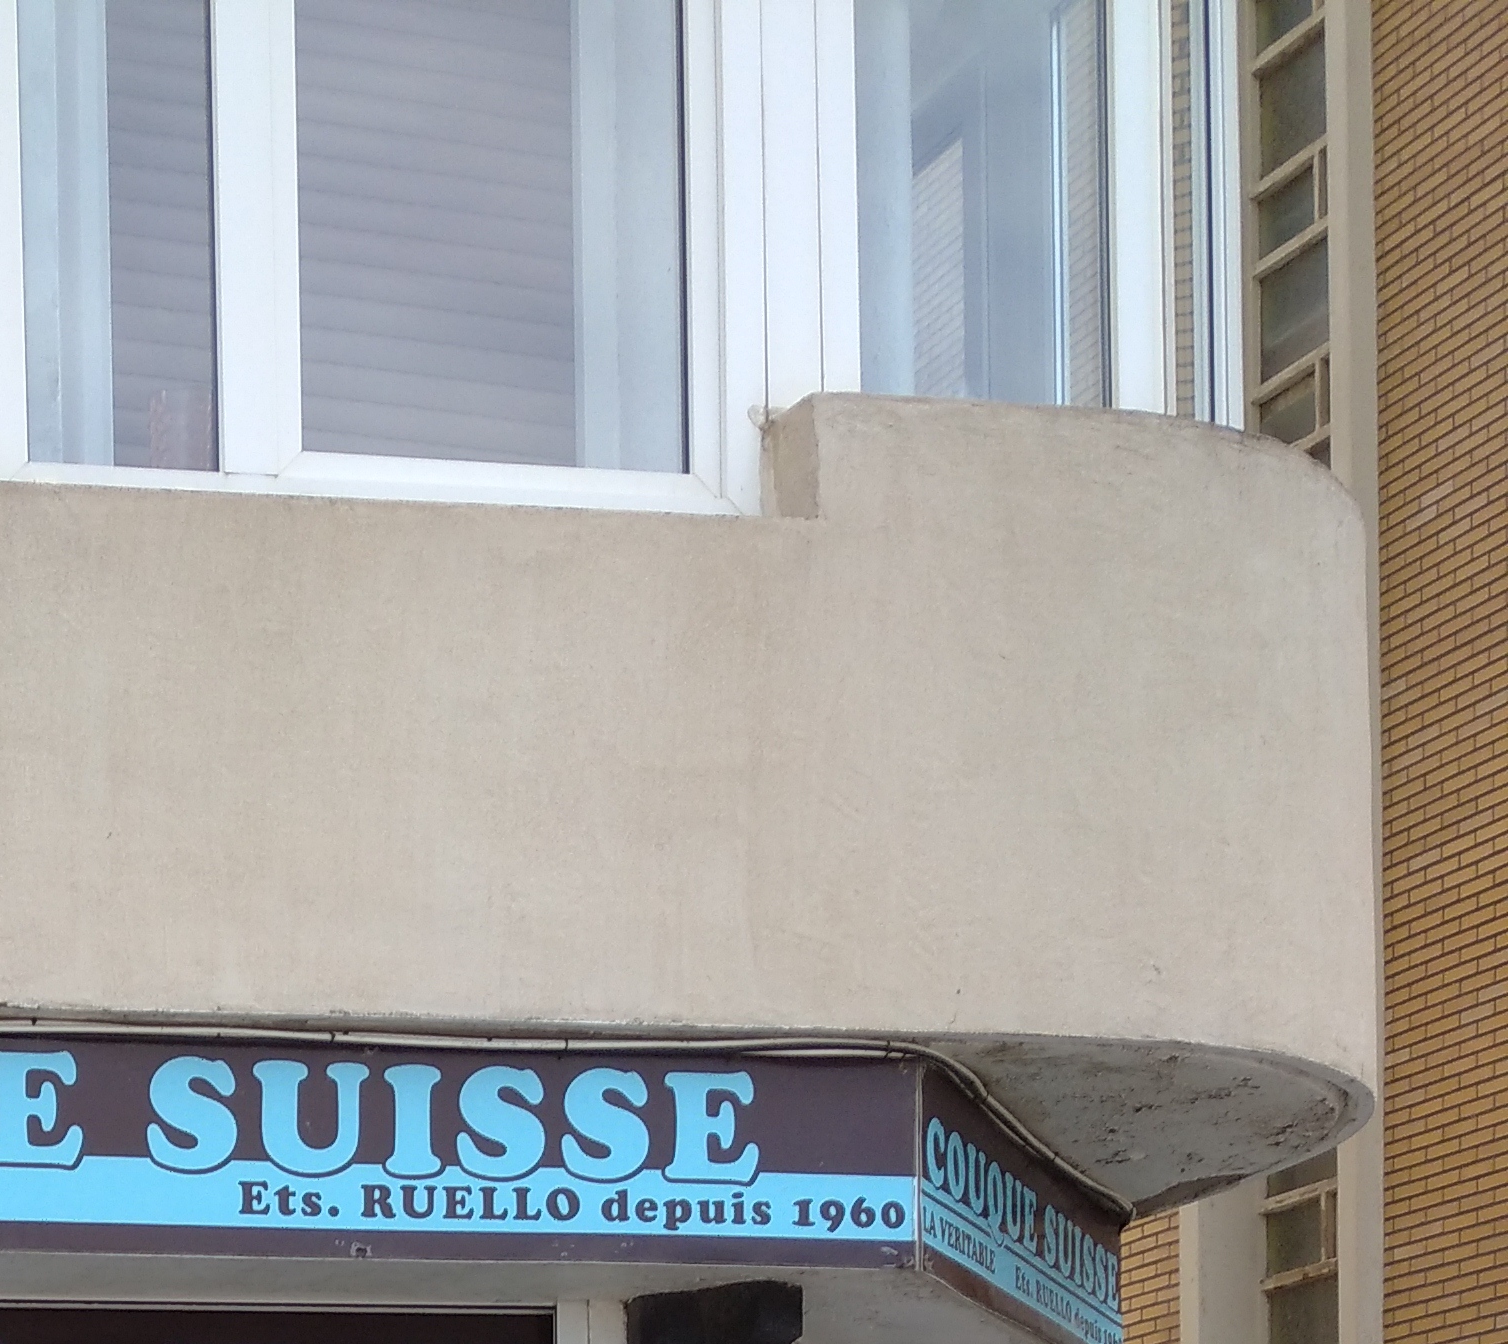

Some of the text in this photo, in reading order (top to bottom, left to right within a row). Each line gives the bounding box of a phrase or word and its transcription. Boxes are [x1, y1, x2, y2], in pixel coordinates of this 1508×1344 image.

[145, 1055, 761, 1186] SUISSE
[238, 1179, 906, 1232] Ets. RUELLO depuis 1960
[923, 1205, 996, 1275] LA VERITABLE
[926, 1116, 1120, 1314] COUQUE SUISSE
[1036, 1279, 1072, 1324] RUELLO
